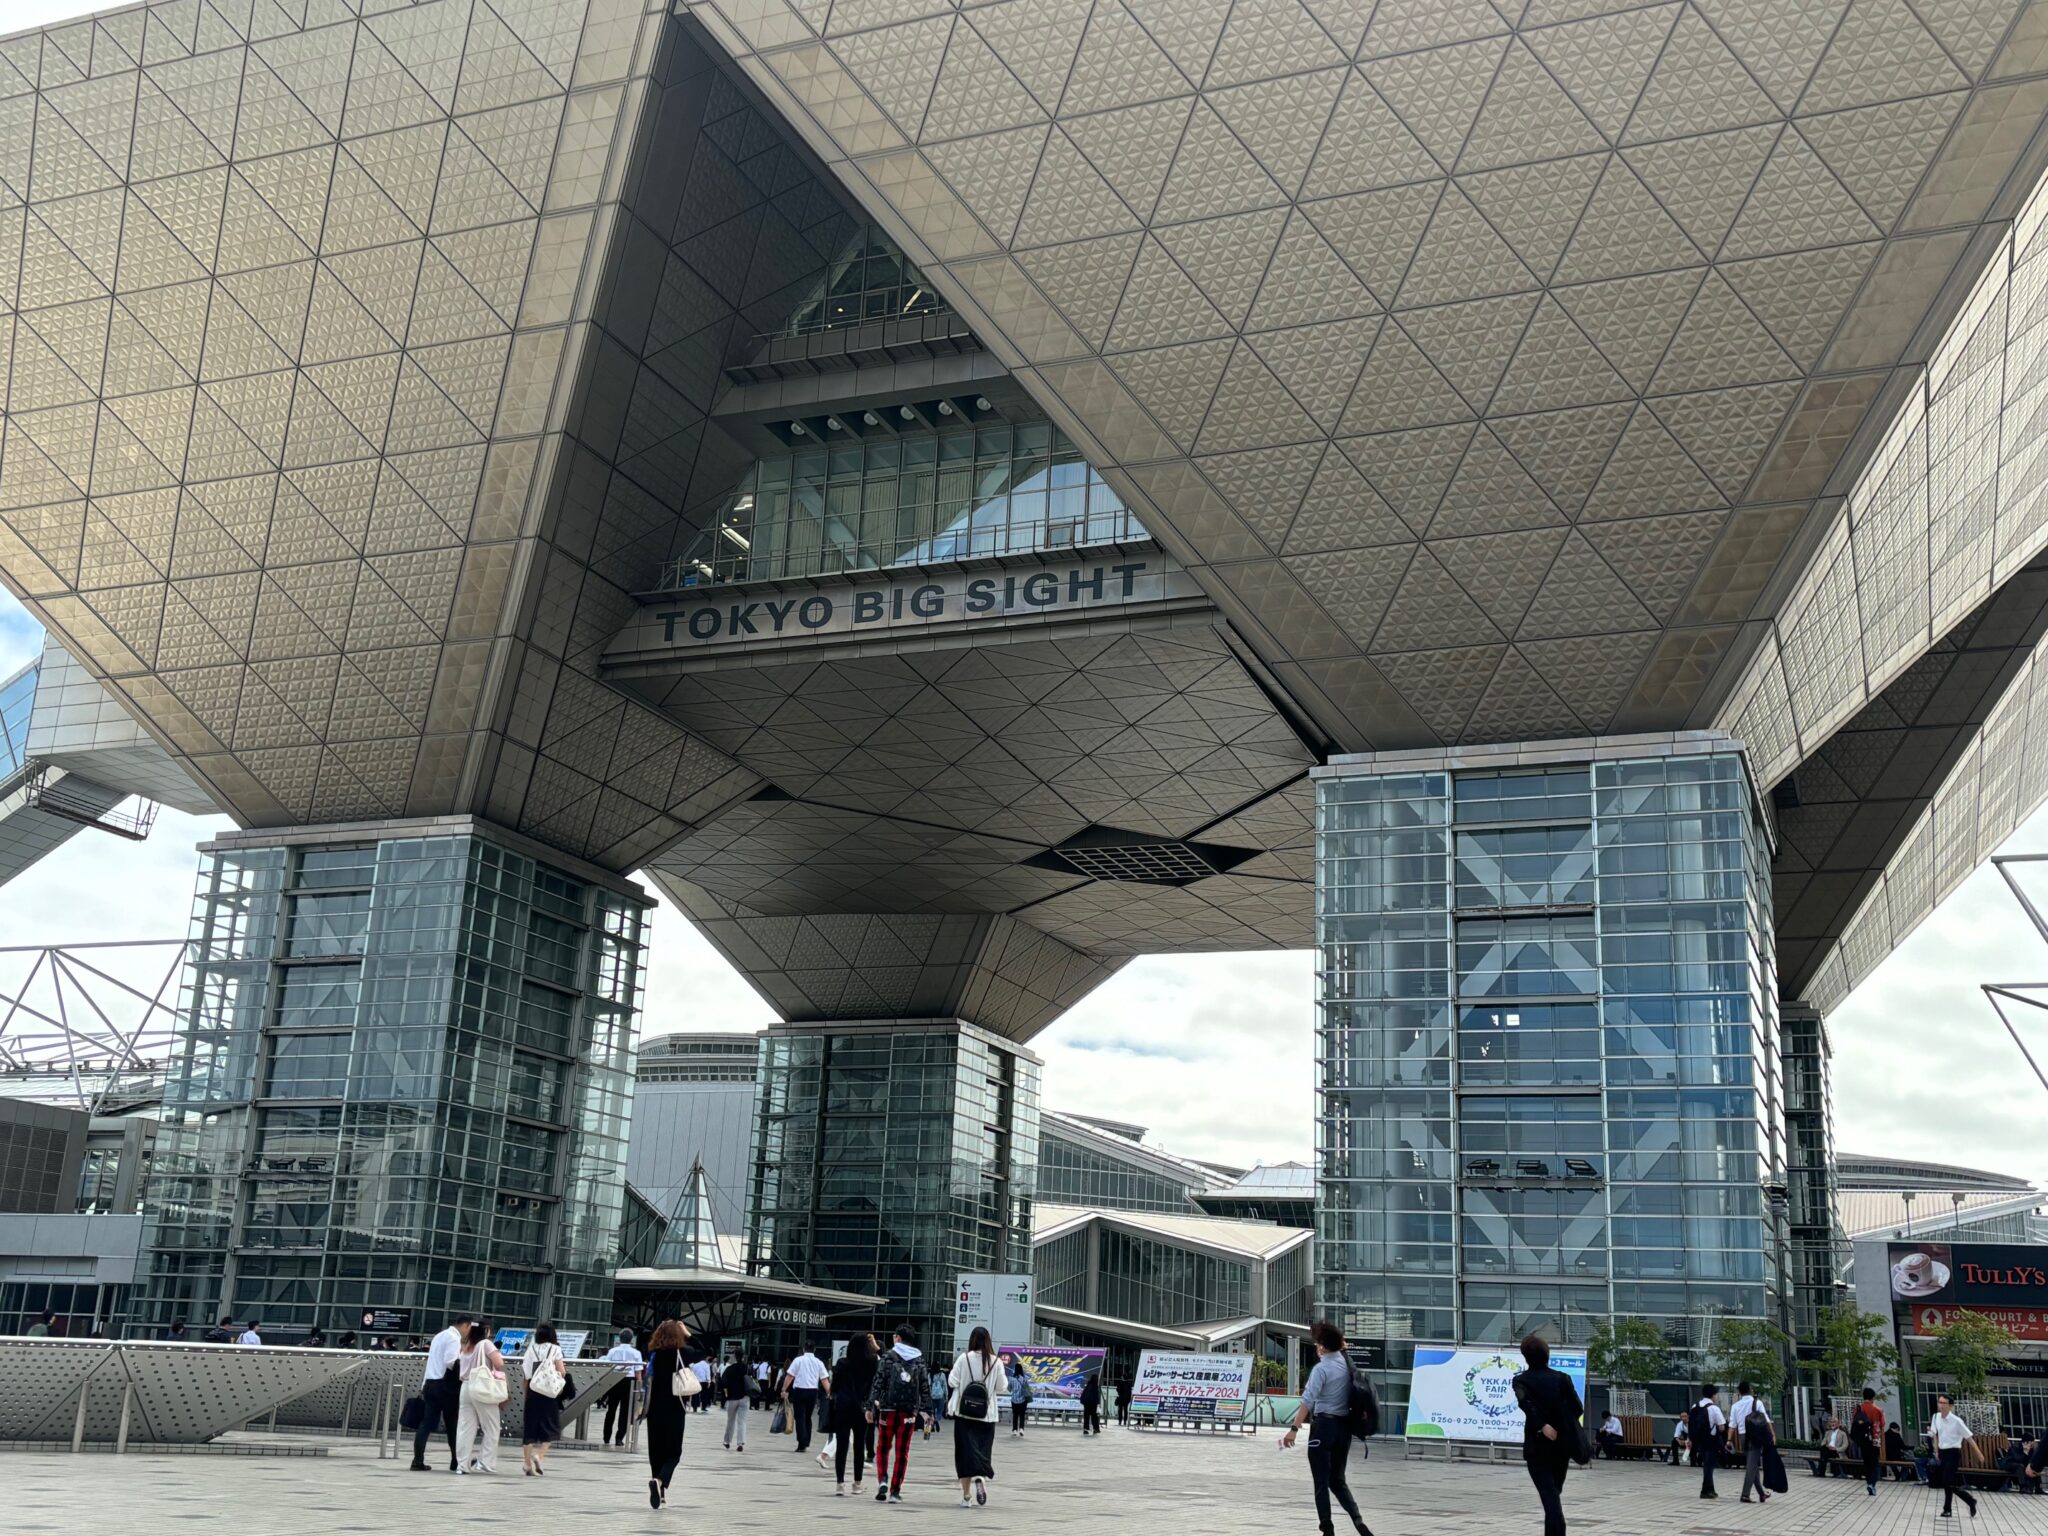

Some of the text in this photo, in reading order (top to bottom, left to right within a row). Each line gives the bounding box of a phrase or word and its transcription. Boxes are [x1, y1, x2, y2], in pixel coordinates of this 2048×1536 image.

[656, 563, 1146, 641] TOKYO BIG SIGHT
[753, 1307, 826, 1325] TOKYO BIG SIGHT
[1220, 1373, 1243, 1382] 2024
[1481, 1378, 1500, 1386] YKK
[1215, 1387, 1240, 1398] 2024
[1485, 1385, 1507, 1393] FAIR
